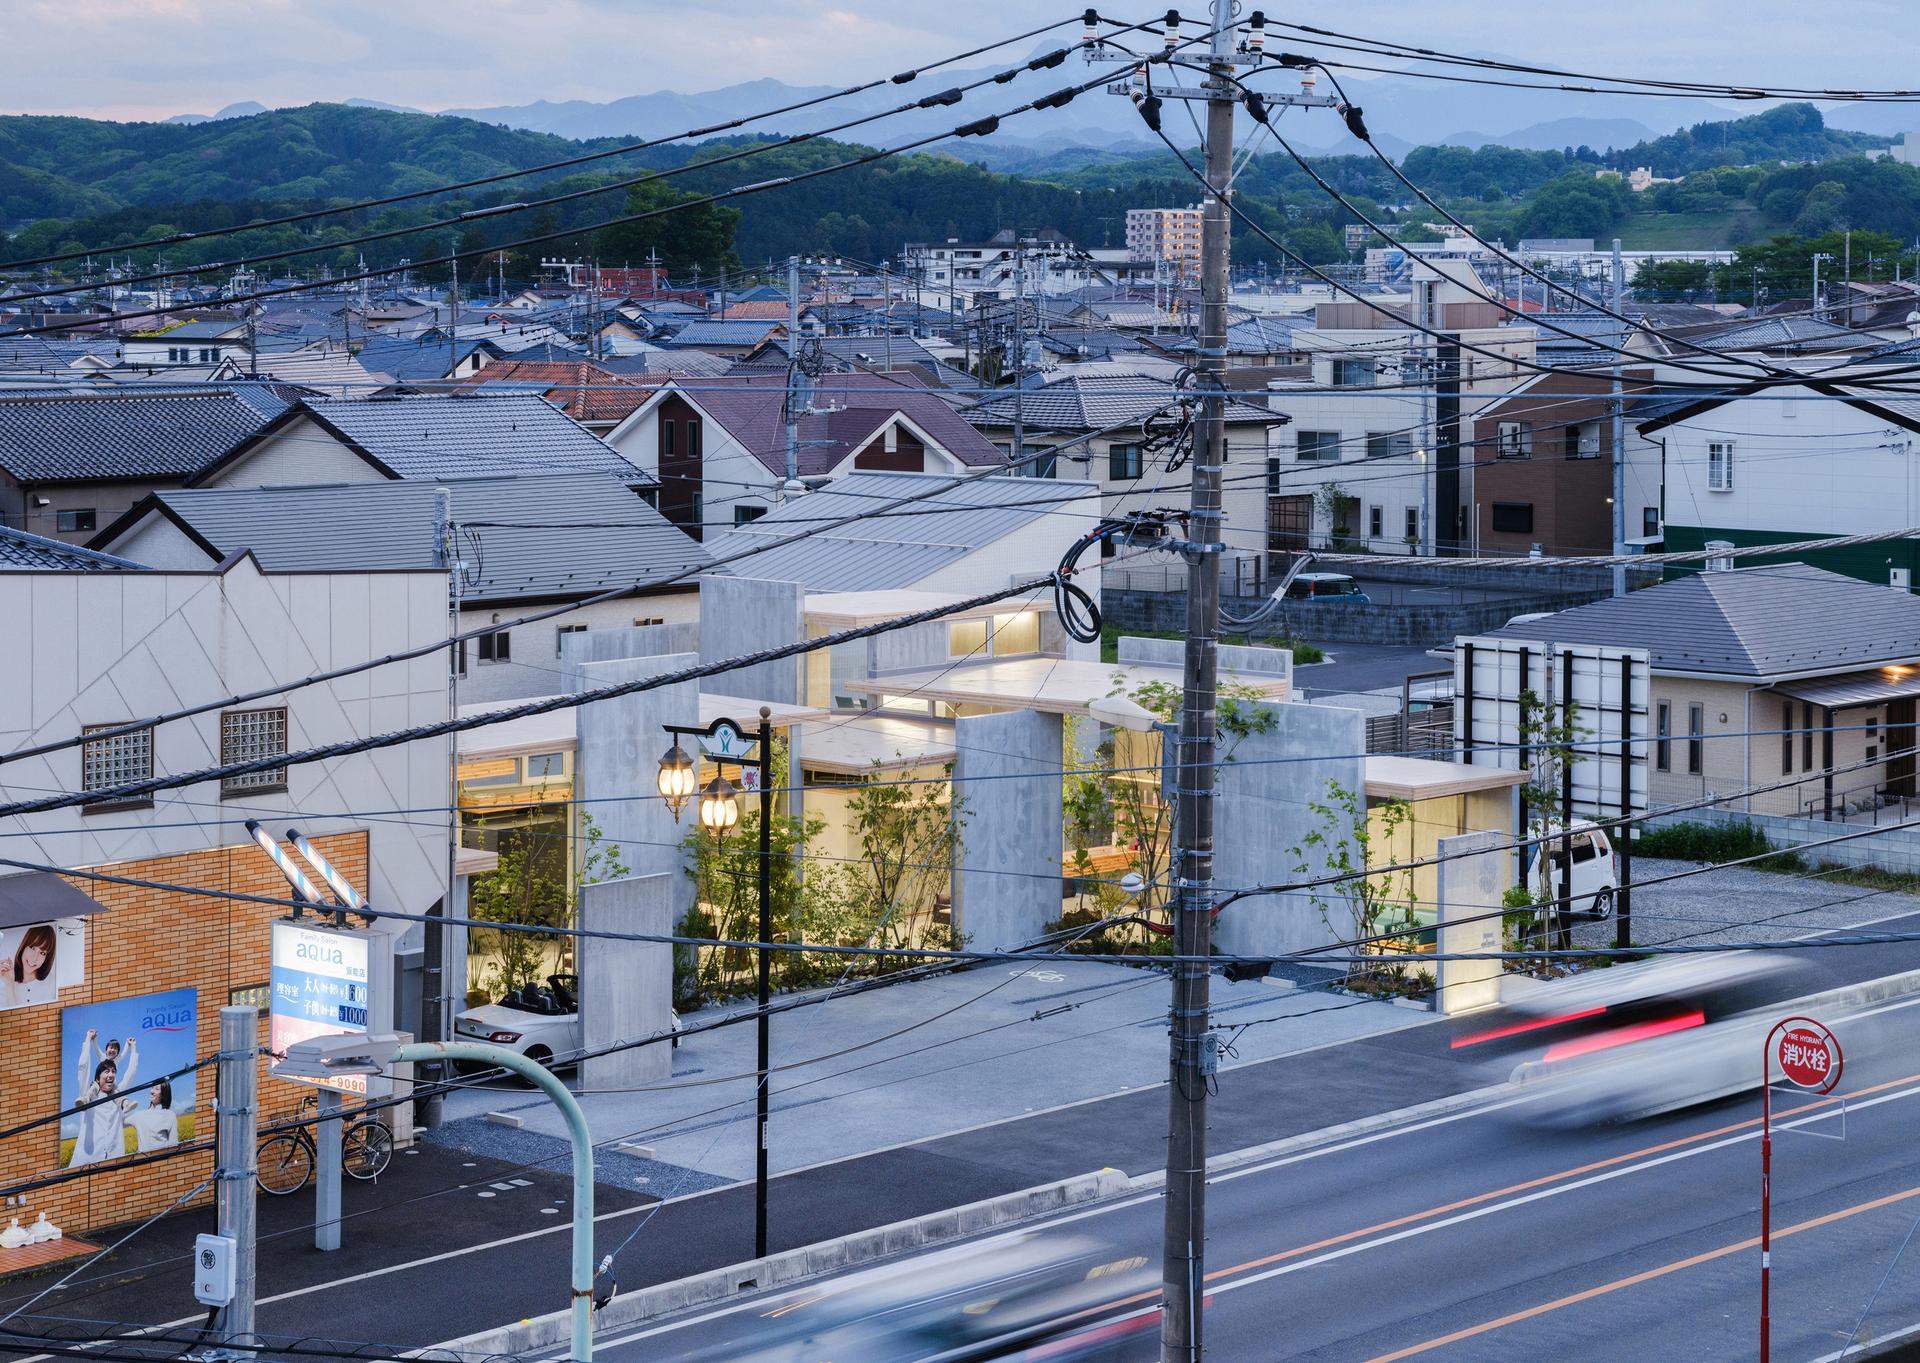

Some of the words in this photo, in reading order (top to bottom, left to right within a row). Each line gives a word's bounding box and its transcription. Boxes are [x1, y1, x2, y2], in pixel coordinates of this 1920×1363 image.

[1787, 1033, 1799, 1041] FIRE
[1800, 1035, 1822, 1045] HYDRANT
[1783, 1042, 1827, 1072] 消火栓
